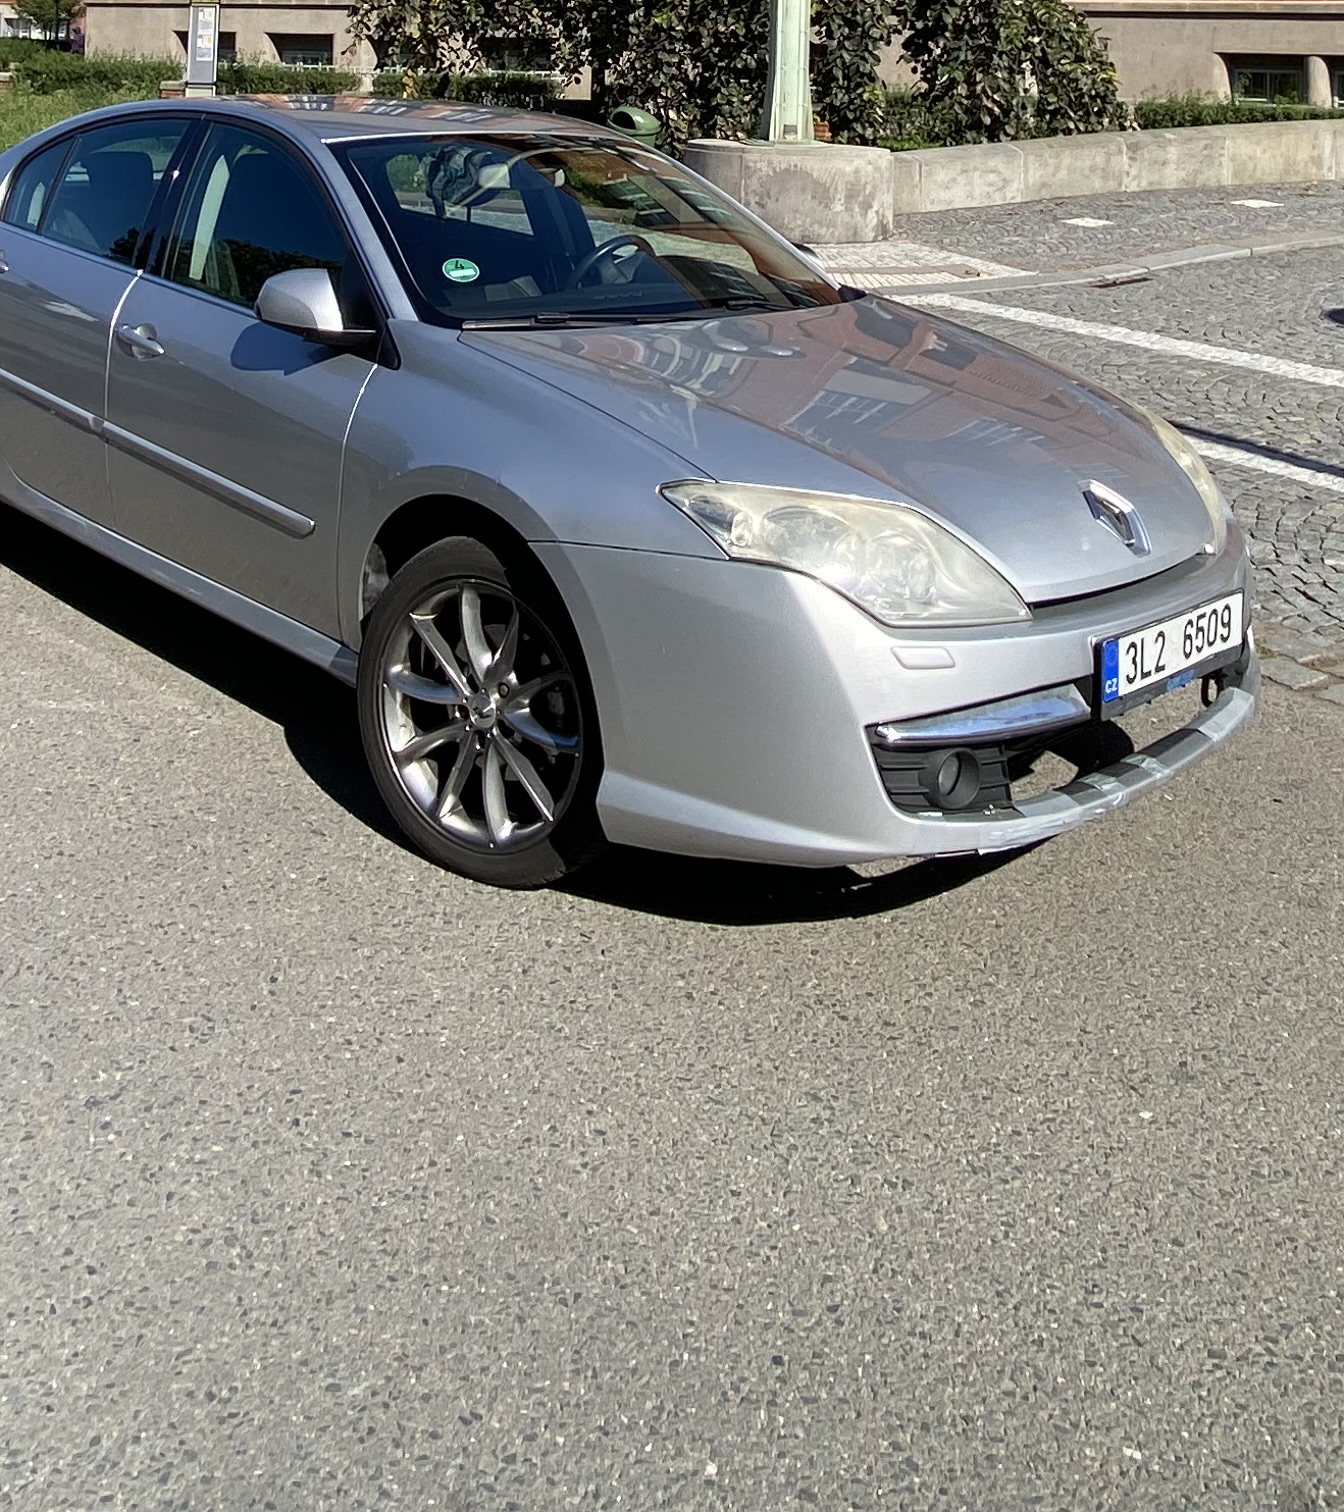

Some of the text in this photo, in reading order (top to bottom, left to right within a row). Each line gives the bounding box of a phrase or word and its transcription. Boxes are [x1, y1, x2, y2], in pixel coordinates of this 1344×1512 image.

[455, 260, 465, 269] 4
[1125, 603, 1232, 684] 3L2 6509
[1105, 678, 1118, 694] CZ
